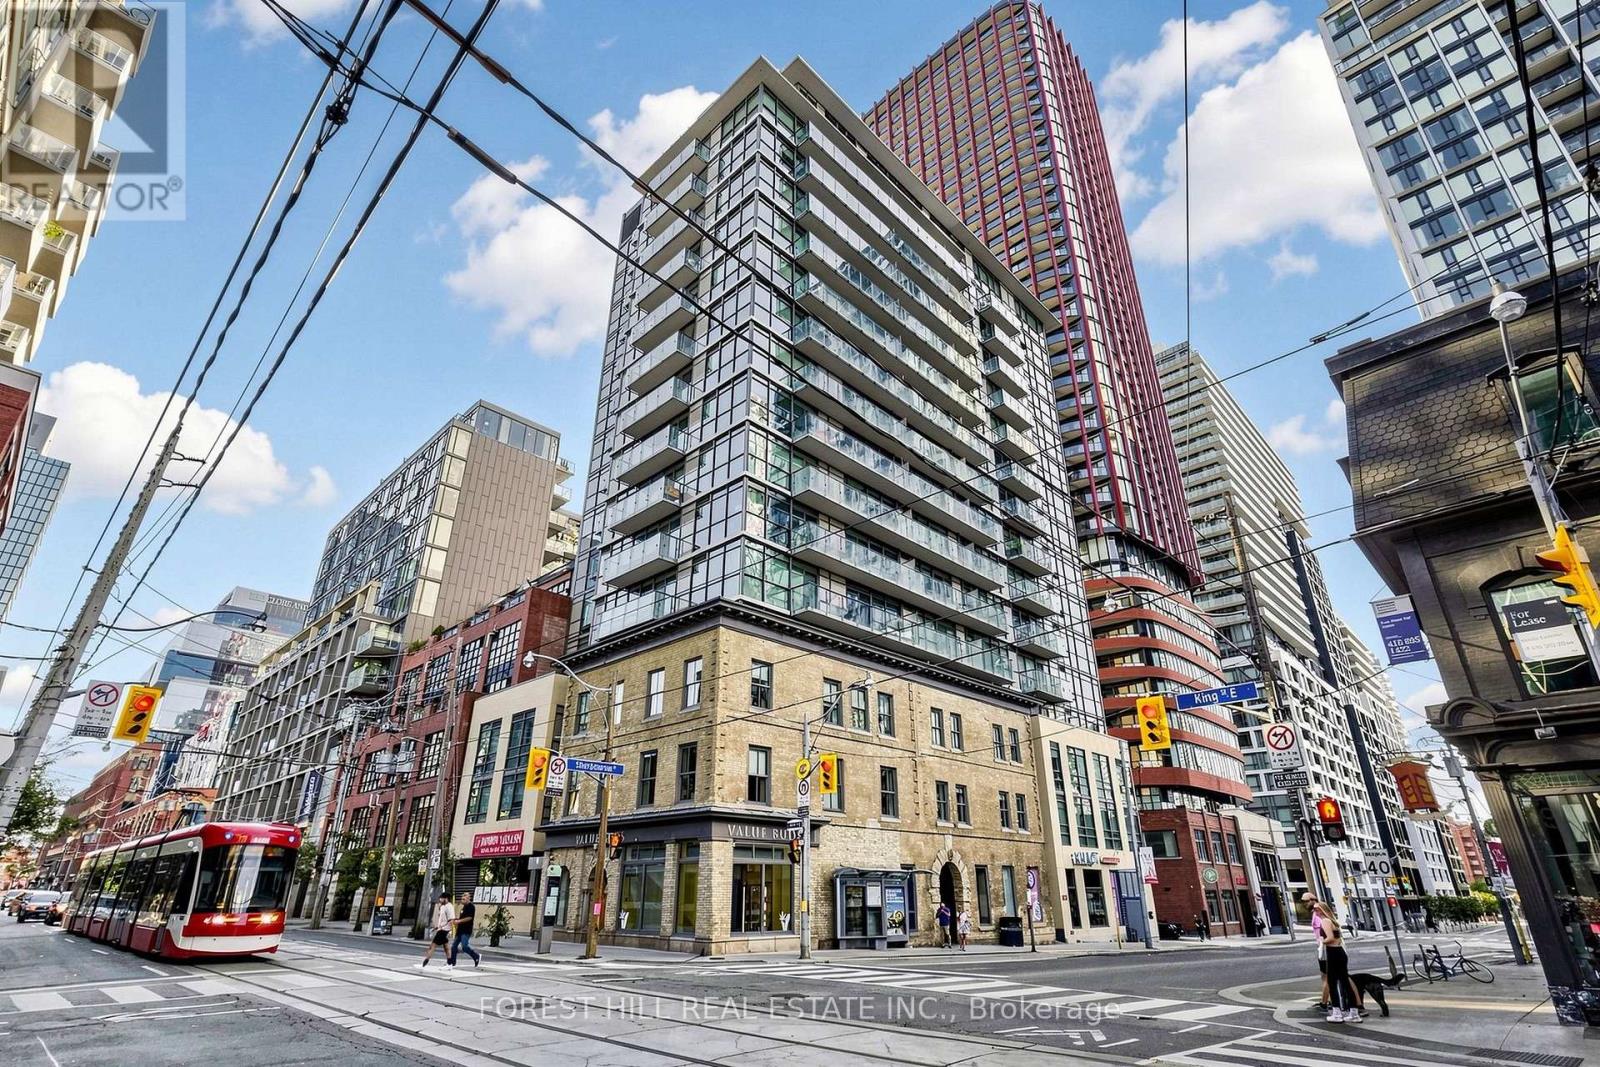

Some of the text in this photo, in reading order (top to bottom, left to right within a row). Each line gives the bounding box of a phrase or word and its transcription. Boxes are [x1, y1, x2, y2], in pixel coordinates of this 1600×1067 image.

[1509, 610, 1530, 620] For
[1512, 616, 1547, 628] Lease
[1194, 693, 1219, 704] King
[1229, 687, 1238, 698] E
[727, 823, 767, 839] VALUE
[1368, 860, 1391, 875] 40
